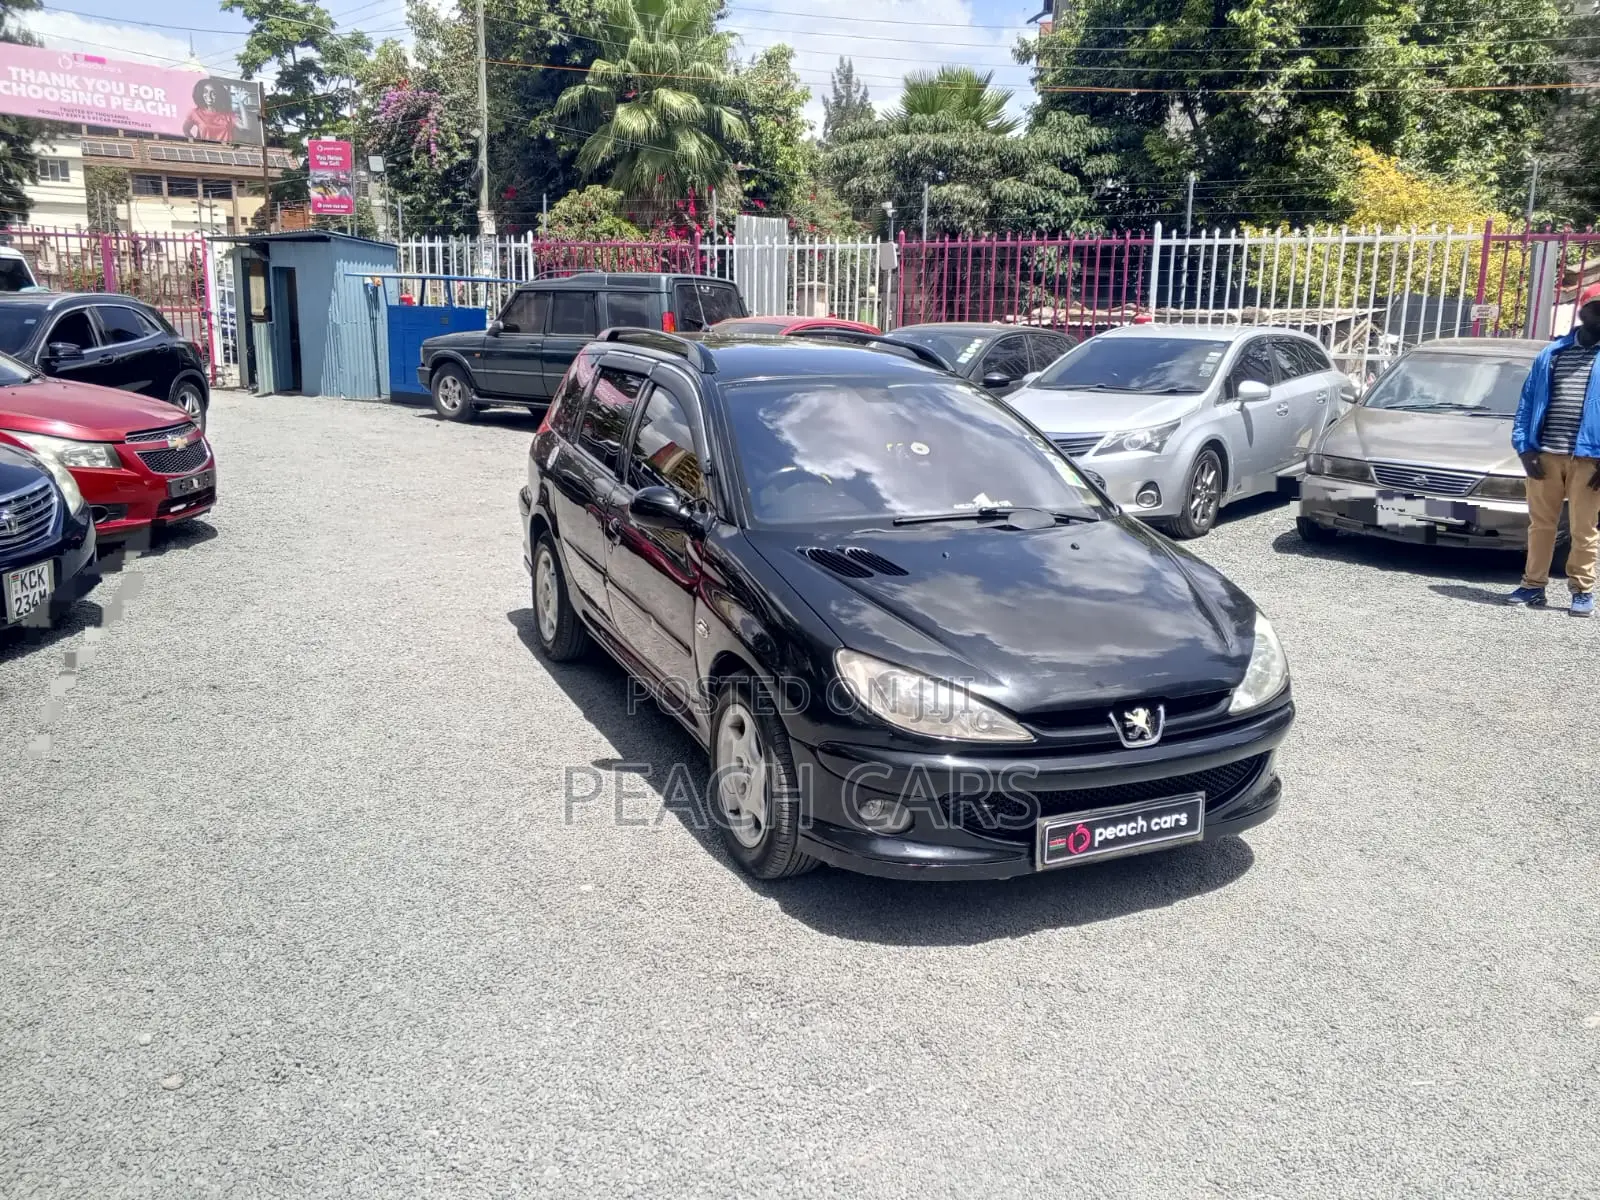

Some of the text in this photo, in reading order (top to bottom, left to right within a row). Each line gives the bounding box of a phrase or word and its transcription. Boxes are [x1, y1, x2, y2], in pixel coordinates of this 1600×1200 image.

[0, 80, 177, 118] CHOOSING PEACH!
[8, 66, 81, 90] THANK
[81, 77, 124, 95] YOU
[129, 83, 166, 102] FOR
[20, 567, 46, 592] KCK
[1094, 812, 1188, 847] peach cars
